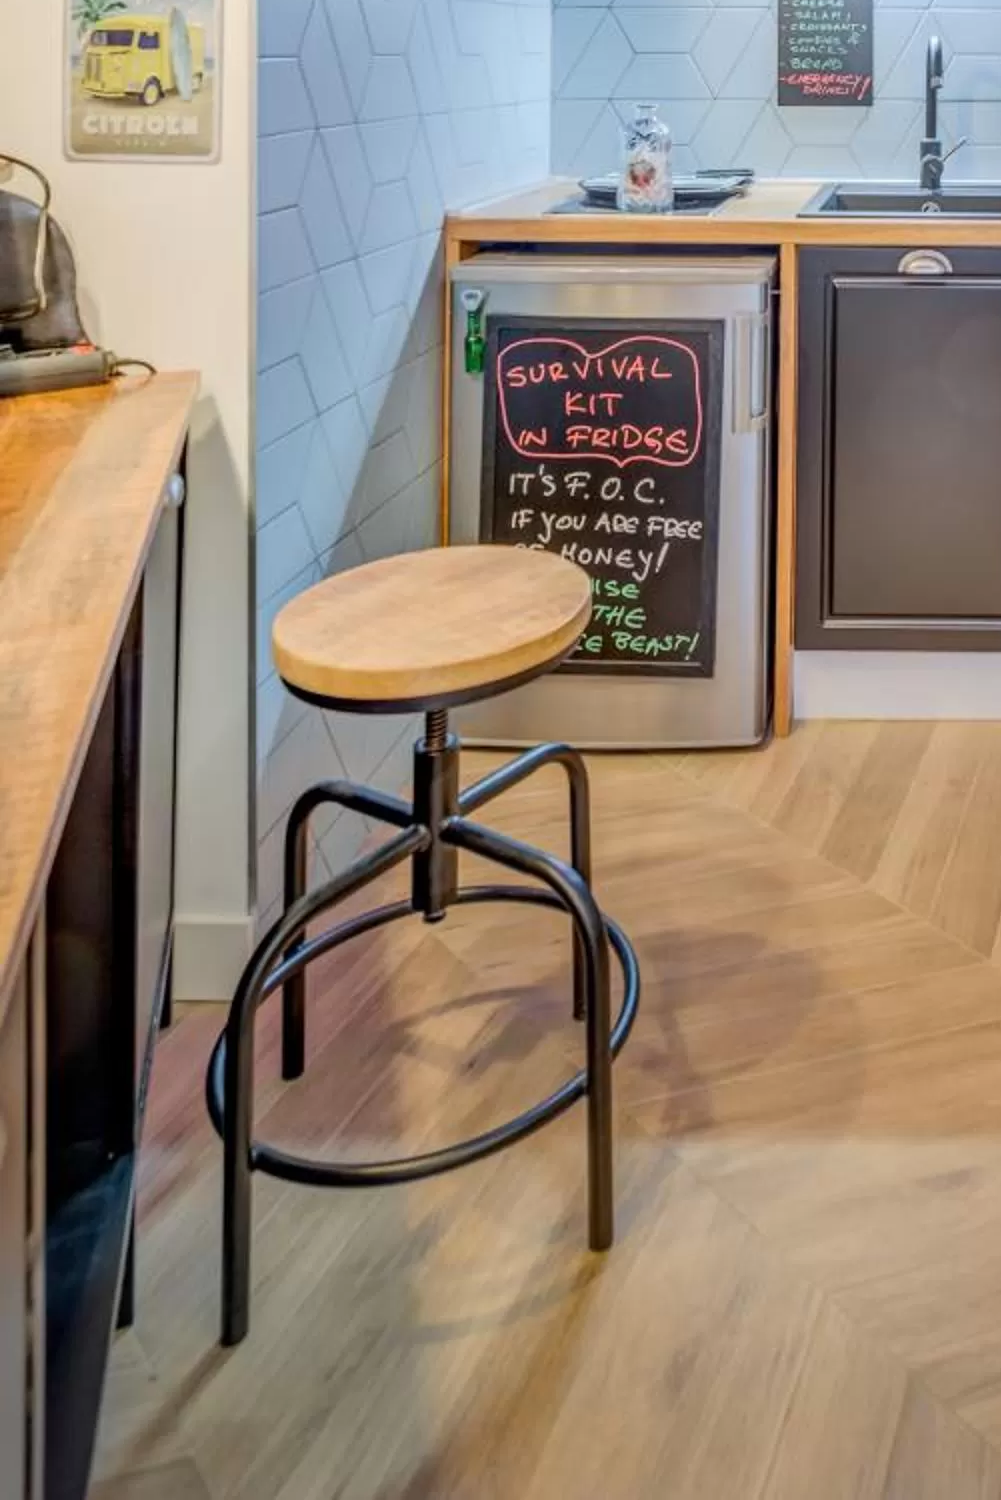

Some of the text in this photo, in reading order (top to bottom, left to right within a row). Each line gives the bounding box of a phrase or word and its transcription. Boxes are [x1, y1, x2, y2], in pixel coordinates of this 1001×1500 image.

[507, 356, 673, 387] SURVIVAL
[564, 391, 623, 416] KIT
[518, 424, 688, 454] IN FRIDGE
[509, 464, 557, 497] IT'S
[511, 509, 702, 543] IF YOU ARE FREE
[593, 605, 647, 629] THE
[611, 631, 700, 660] BEAST!
